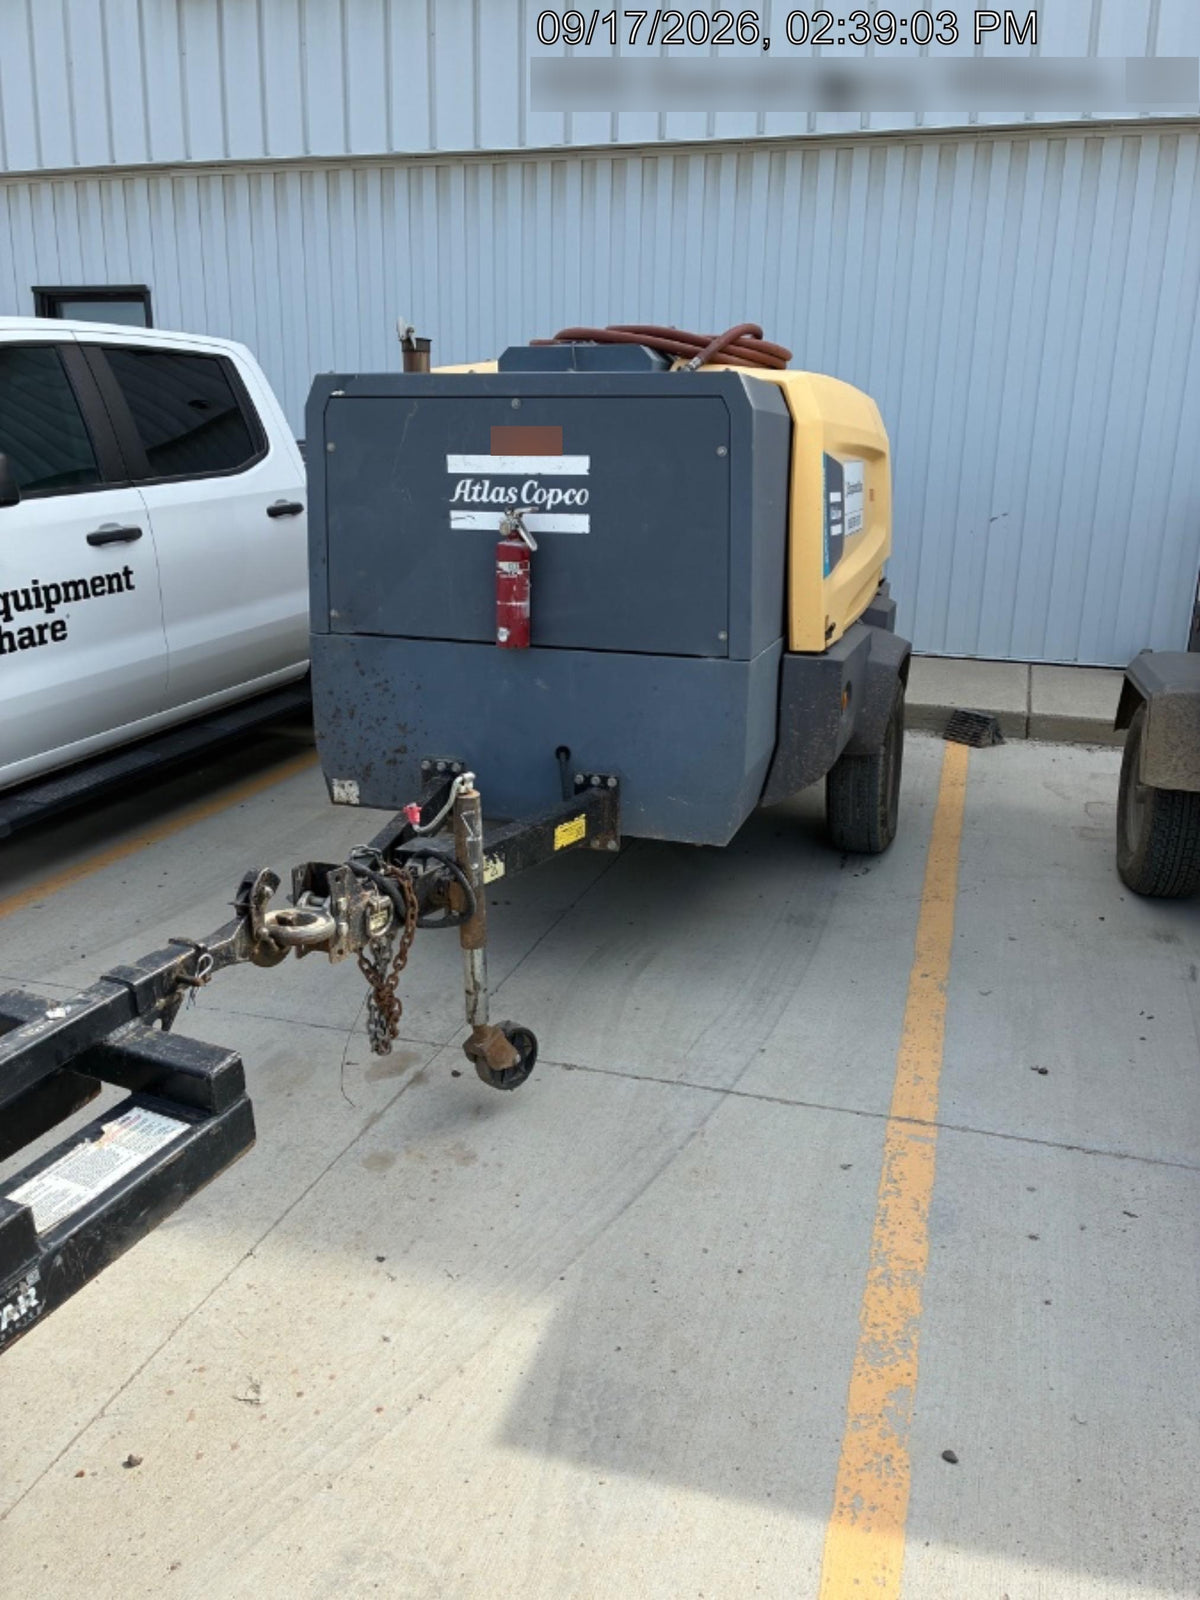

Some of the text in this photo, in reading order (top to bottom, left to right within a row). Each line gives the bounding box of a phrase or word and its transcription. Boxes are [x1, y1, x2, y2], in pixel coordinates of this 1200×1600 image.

[449, 478, 590, 510] Atlas Copco
[0, 565, 136, 623] quipment
[0, 619, 69, 655] hare
[0, 1286, 40, 1332] AR
